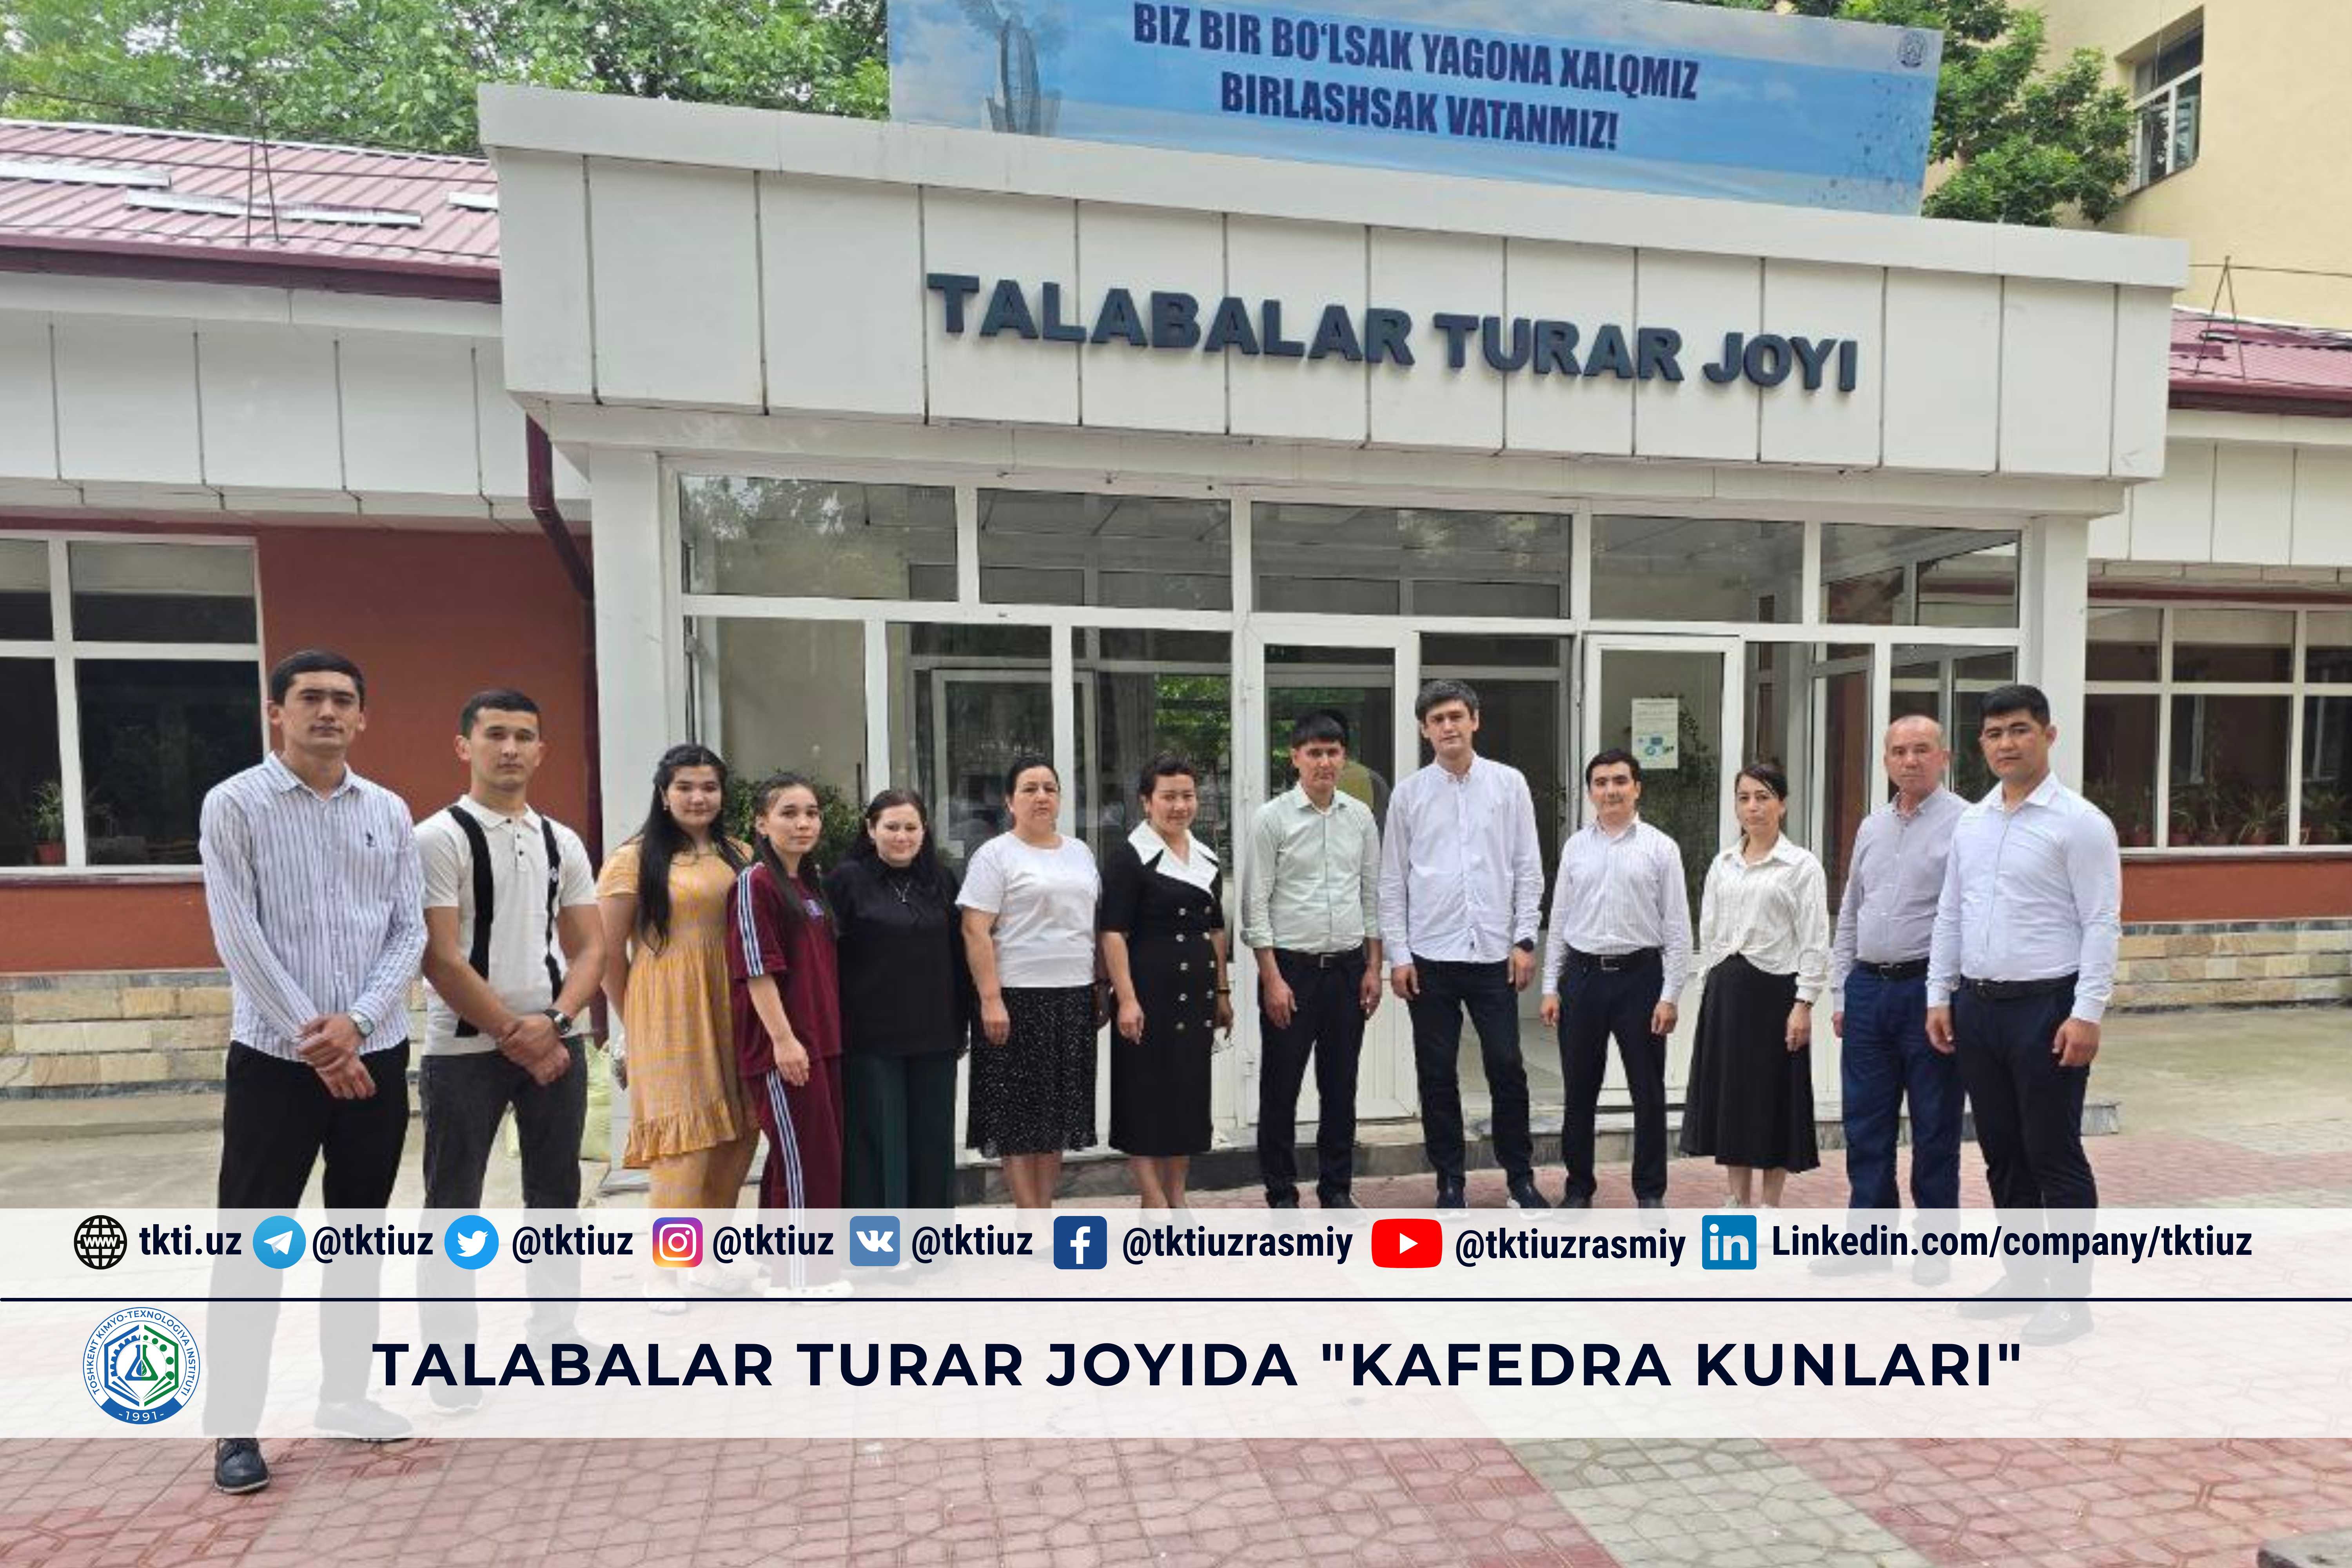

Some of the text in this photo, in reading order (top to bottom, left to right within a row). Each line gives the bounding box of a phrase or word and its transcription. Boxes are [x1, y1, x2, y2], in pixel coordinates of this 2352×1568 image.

[1134, 2, 1190, 47] BIZ
[1200, 9, 1261, 54] BIR
[1421, 33, 1552, 85] YAGONA
[1560, 47, 1700, 100] XALQMIZ
[1221, 71, 1620, 150] BIRLASHSAK VATANMIZ!
[926, 273, 1858, 391] TALABALAR TURAR JOYI
